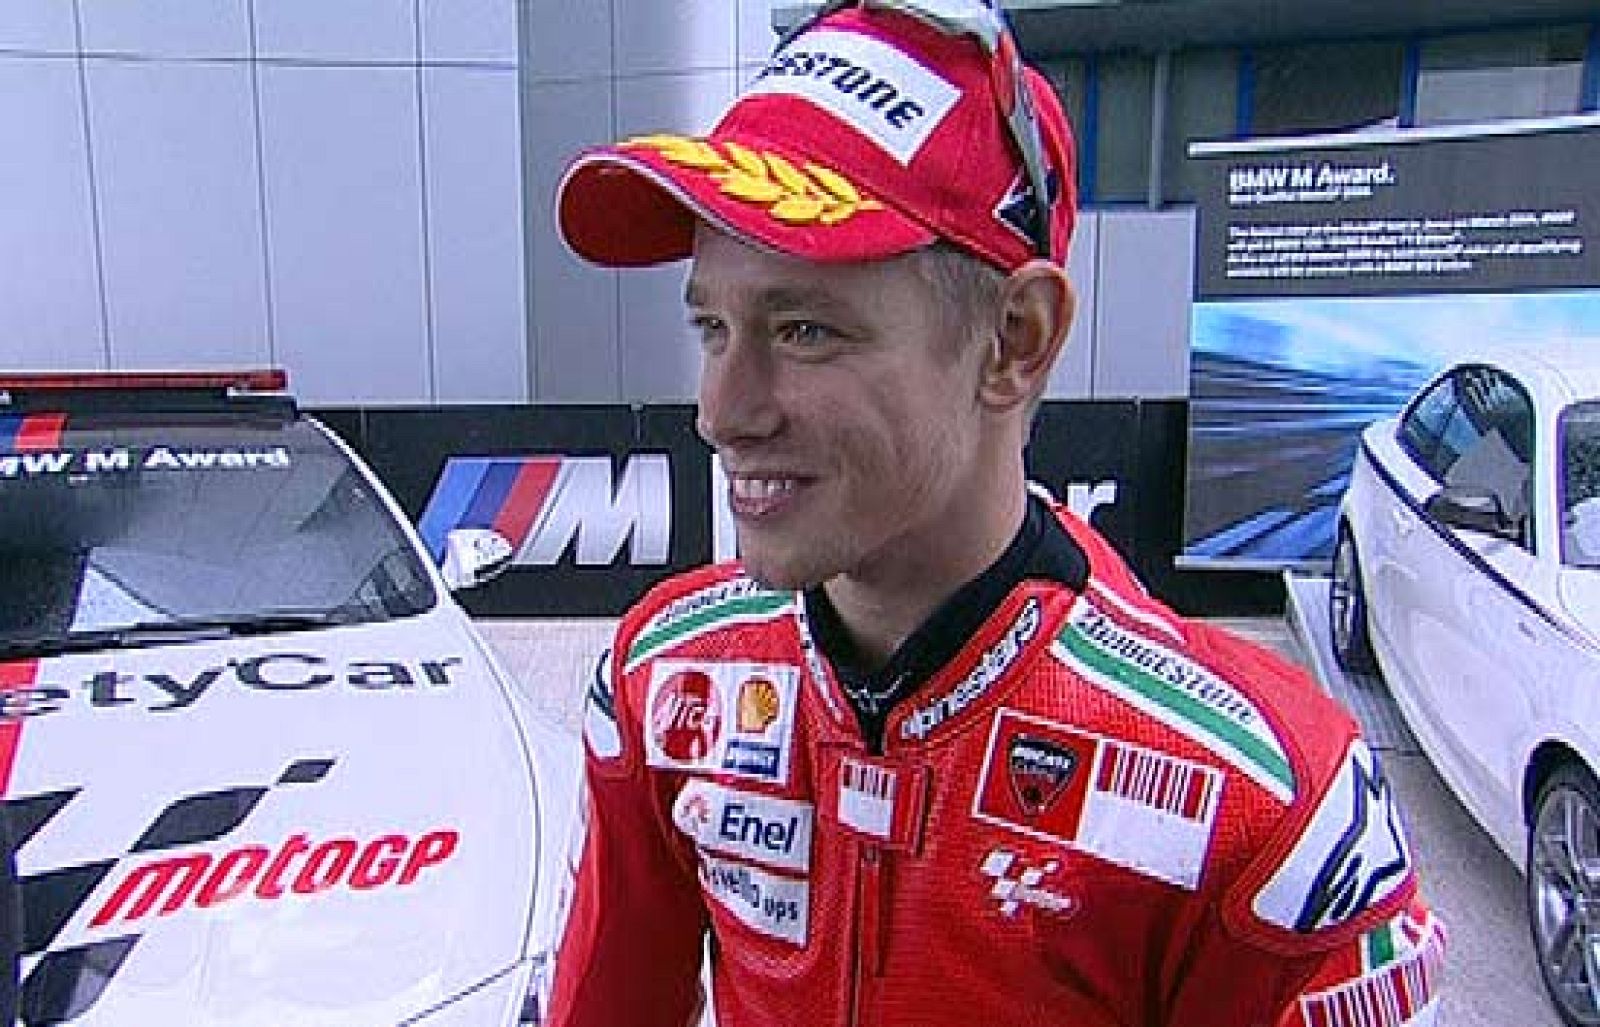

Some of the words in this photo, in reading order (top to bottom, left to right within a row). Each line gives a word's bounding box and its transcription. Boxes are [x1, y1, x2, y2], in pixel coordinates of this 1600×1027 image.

[1230, 166, 1286, 192] BMW
[1291, 167, 1313, 187] M
[85, 452, 129, 471] M
[143, 447, 290, 469] Award
[718, 803, 799, 853] Enel
[763, 897, 800, 924] ups
